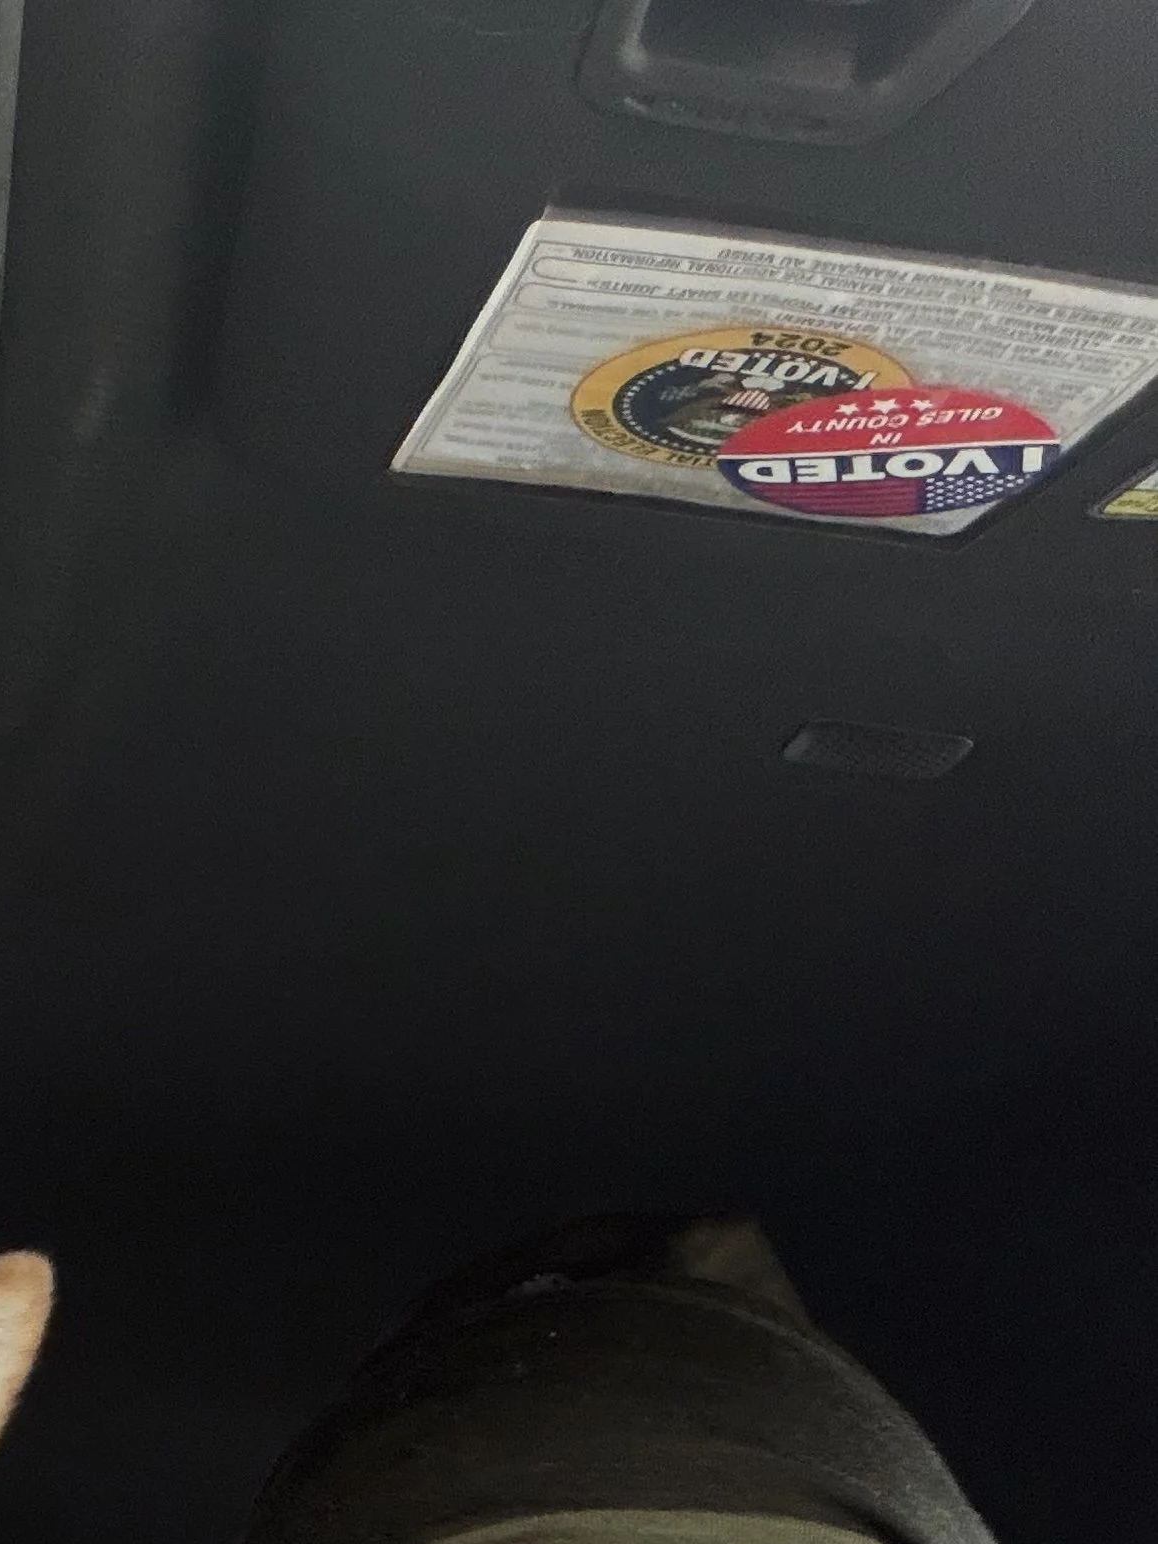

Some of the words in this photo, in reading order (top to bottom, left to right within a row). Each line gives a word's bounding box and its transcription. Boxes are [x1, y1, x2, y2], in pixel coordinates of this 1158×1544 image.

[818, 276, 885, 293] MANUAL
[750, 332, 853, 356] 2024
[678, 348, 841, 386] VOTED
[785, 413, 909, 434] COUNTY
[915, 406, 1003, 428] GILES
[869, 432, 902, 445] IN
[737, 448, 999, 484] VOTED
[1021, 444, 1044, 472] I
